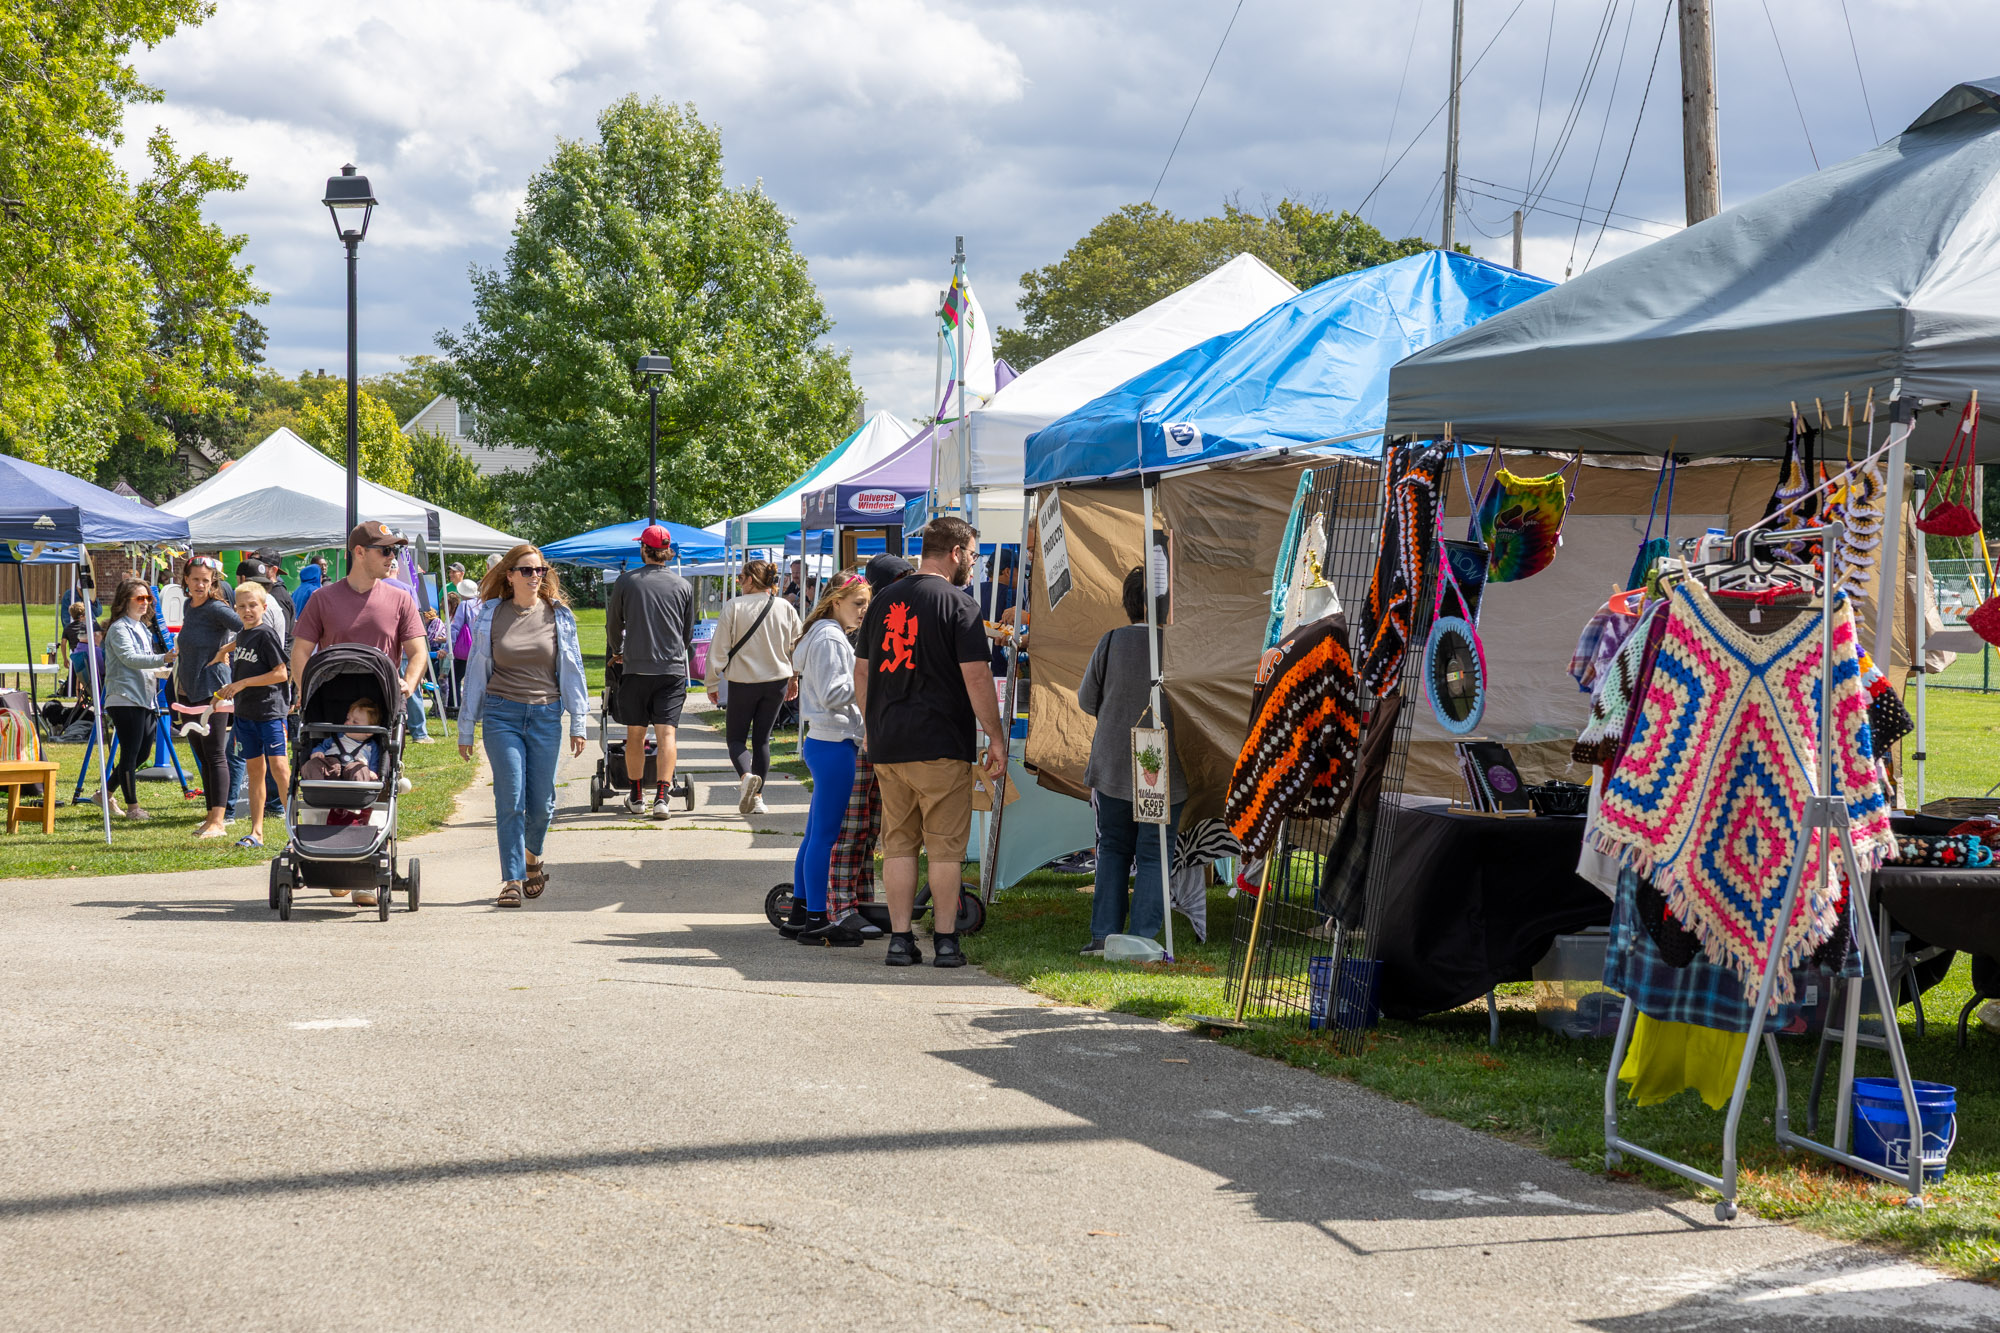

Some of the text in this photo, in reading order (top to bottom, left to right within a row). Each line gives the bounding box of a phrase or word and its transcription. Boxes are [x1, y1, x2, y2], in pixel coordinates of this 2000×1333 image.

[858, 493, 897, 502] Universal
[858, 501, 895, 510] Windows
[1043, 523, 1063, 559] PRODUCTS
[1138, 788, 1165, 800] Welcome
[1143, 798, 1165, 809] GOOD
